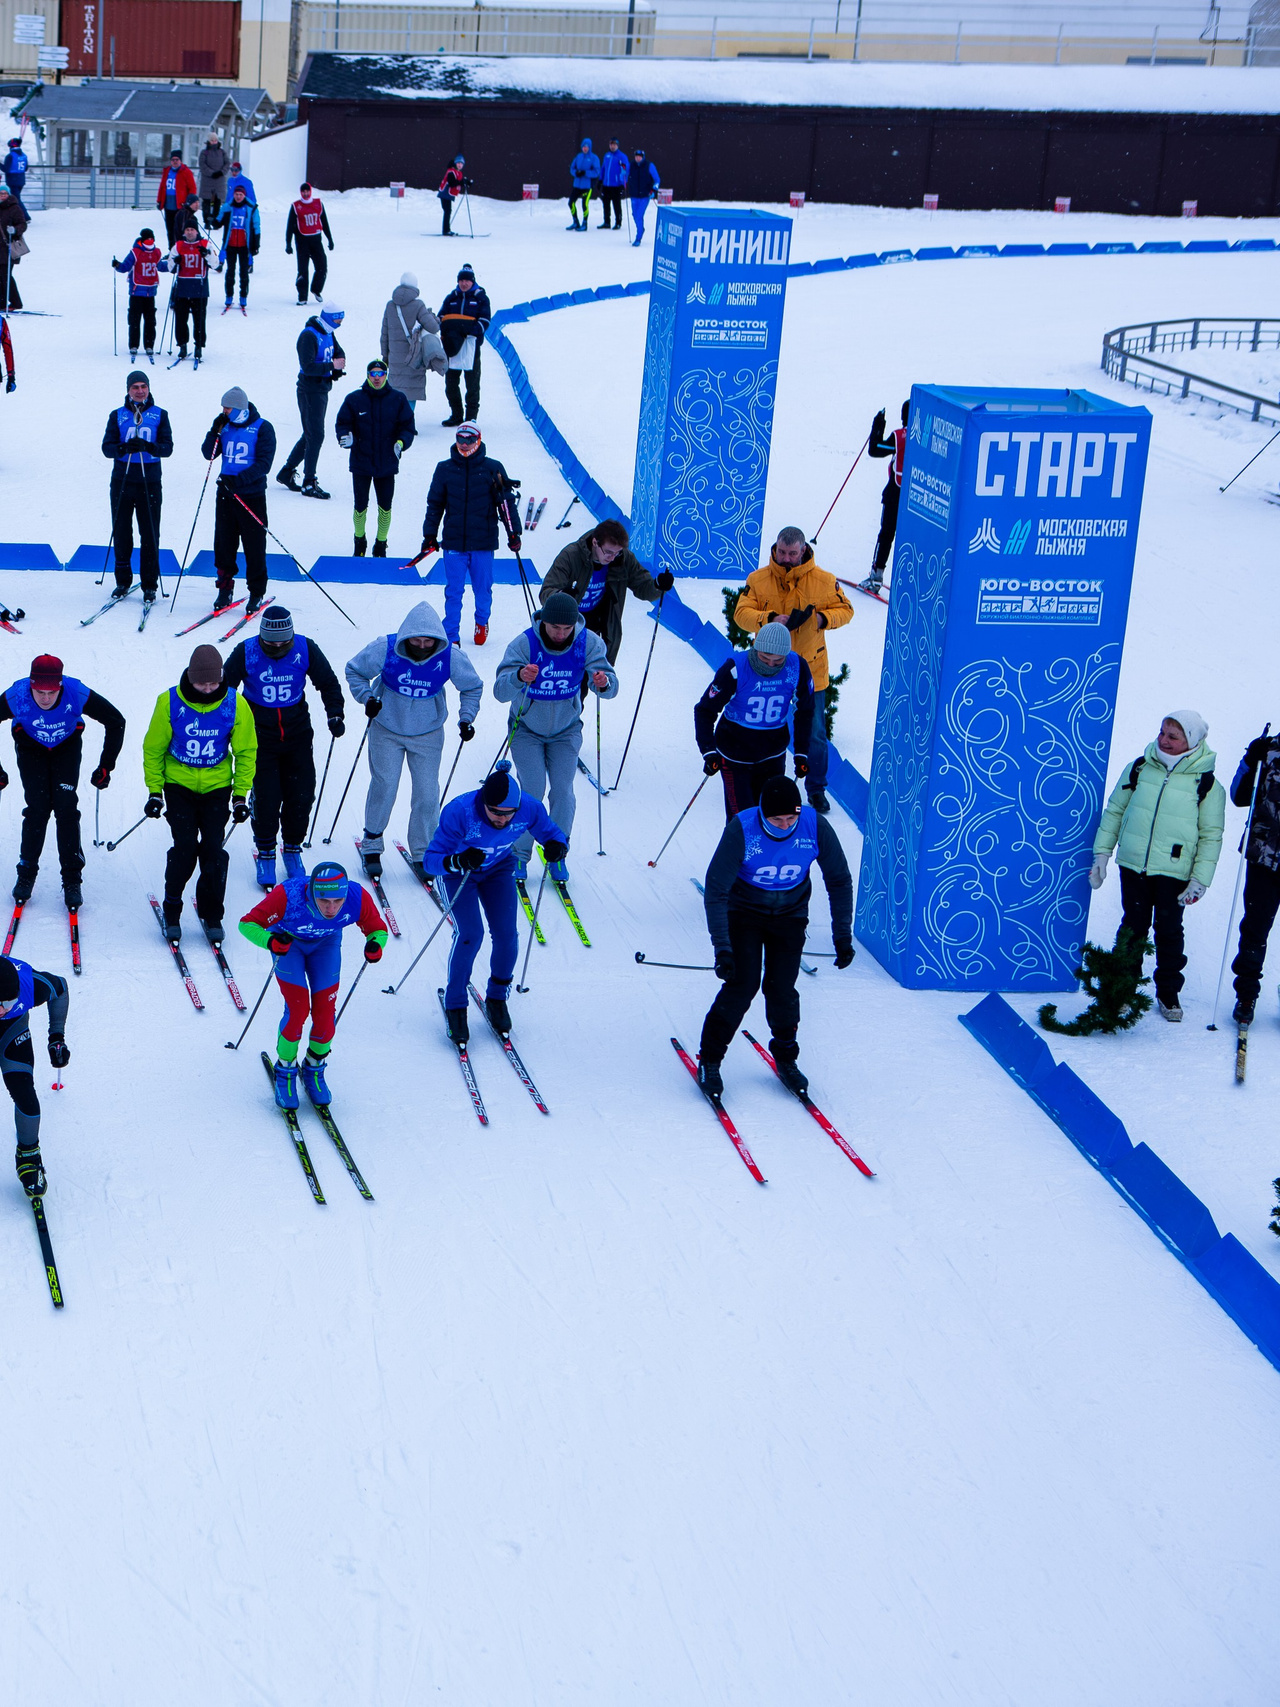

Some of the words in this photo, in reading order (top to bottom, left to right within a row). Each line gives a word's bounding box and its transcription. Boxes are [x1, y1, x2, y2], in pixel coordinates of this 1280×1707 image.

[83, 5, 95, 54] TRITON
[304, 213, 319, 227] 107
[687, 228, 790, 265] ФИНИШ
[183, 254, 199, 268] 121
[141, 262, 157, 277] 123
[728, 282, 782, 295] МОСКОВСКАЯ
[726, 294, 757, 306] ЛЫЖНЯ
[694, 319, 767, 329] ЮГО-ВОСТОК
[224, 441, 249, 465] 42
[975, 432, 1138, 498] СТАРТ
[911, 464, 952, 498] ЮГО-ВОСТОК
[1038, 519, 1128, 537] МОСКОВСКАЯ
[1035, 538, 1087, 556] ЛЫЖНЯ
[980, 579, 1103, 593] ЮГО-ВОСТОК
[265, 620, 292, 629] PUMA
[273, 674, 294, 683] МОЭК
[553, 670, 573, 678] МОЭК
[411, 679, 432, 687] МОЭК
[262, 684, 292, 703] 95
[745, 695, 785, 723] 36
[45, 721, 66, 730] МОЭК
[199, 729, 219, 737] МОЭК
[185, 739, 216, 757] 94
[46, 1266, 62, 1303] FISCHER
